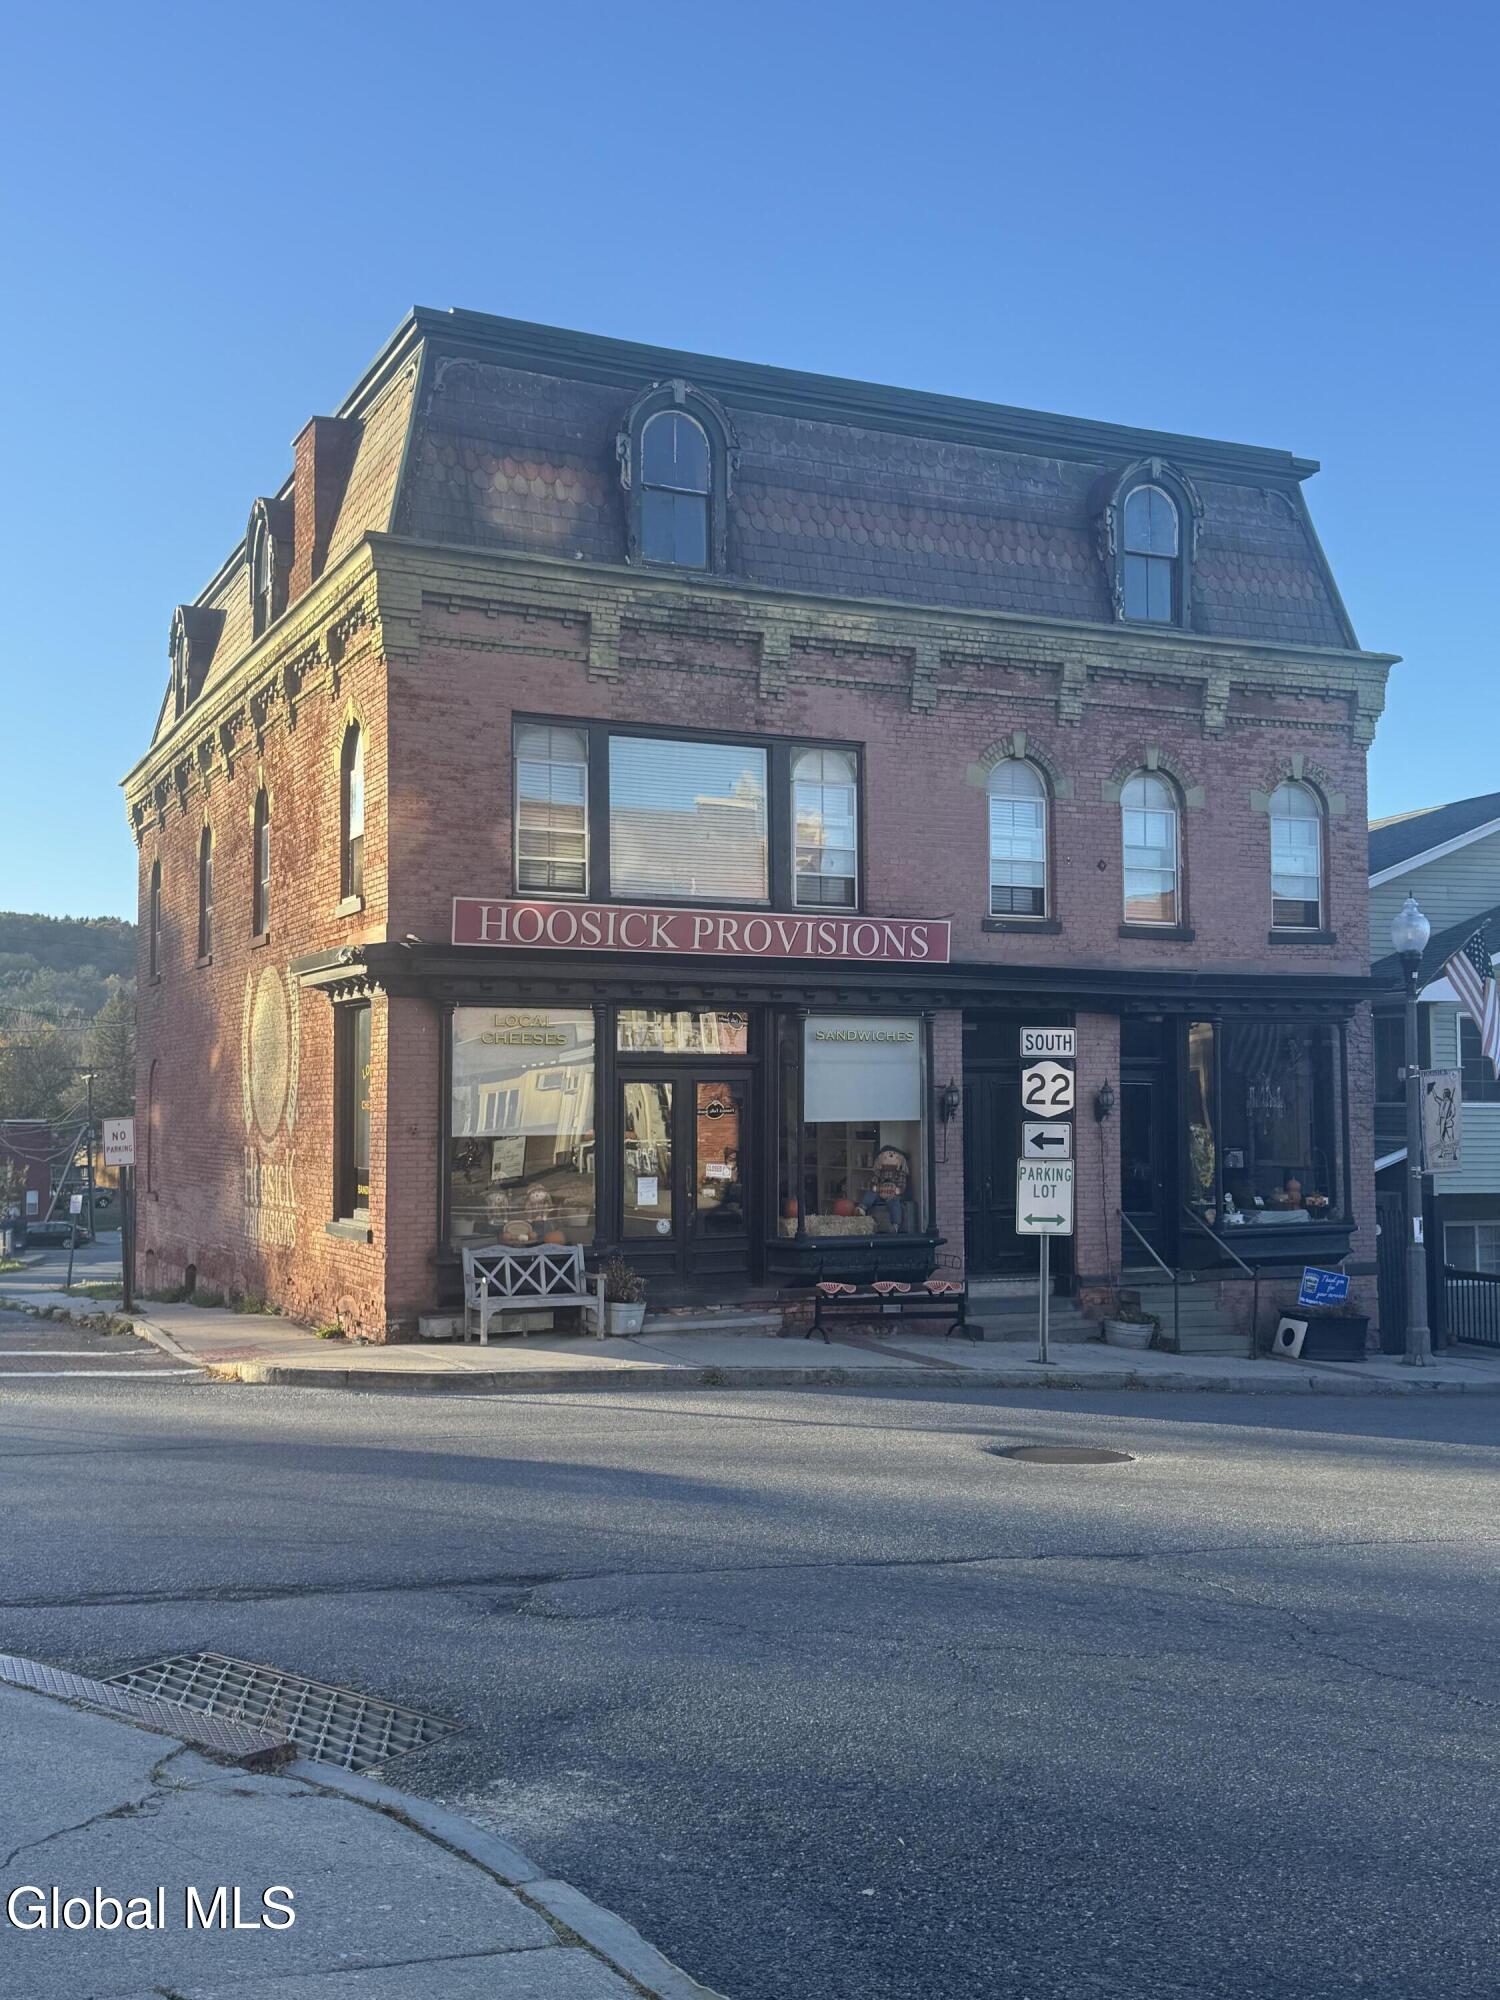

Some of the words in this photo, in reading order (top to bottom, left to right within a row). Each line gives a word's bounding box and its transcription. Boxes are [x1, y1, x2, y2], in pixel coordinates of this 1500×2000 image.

[478, 906, 679, 949] HOOSICK
[691, 915, 929, 958] PROVISIONS
[494, 1014, 555, 1028] LOCAL
[481, 1032, 568, 1046] CHEESES
[815, 1029, 915, 1043] SANDWICHES
[1025, 1034, 1073, 1051] SOUTH
[1026, 1072, 1071, 1106] 22
[112, 1131, 126, 1141] NO
[106, 1145, 133, 1153] PARKING
[1020, 1167, 1072, 1182] PARKING
[1033, 1185, 1057, 1199] LOT
